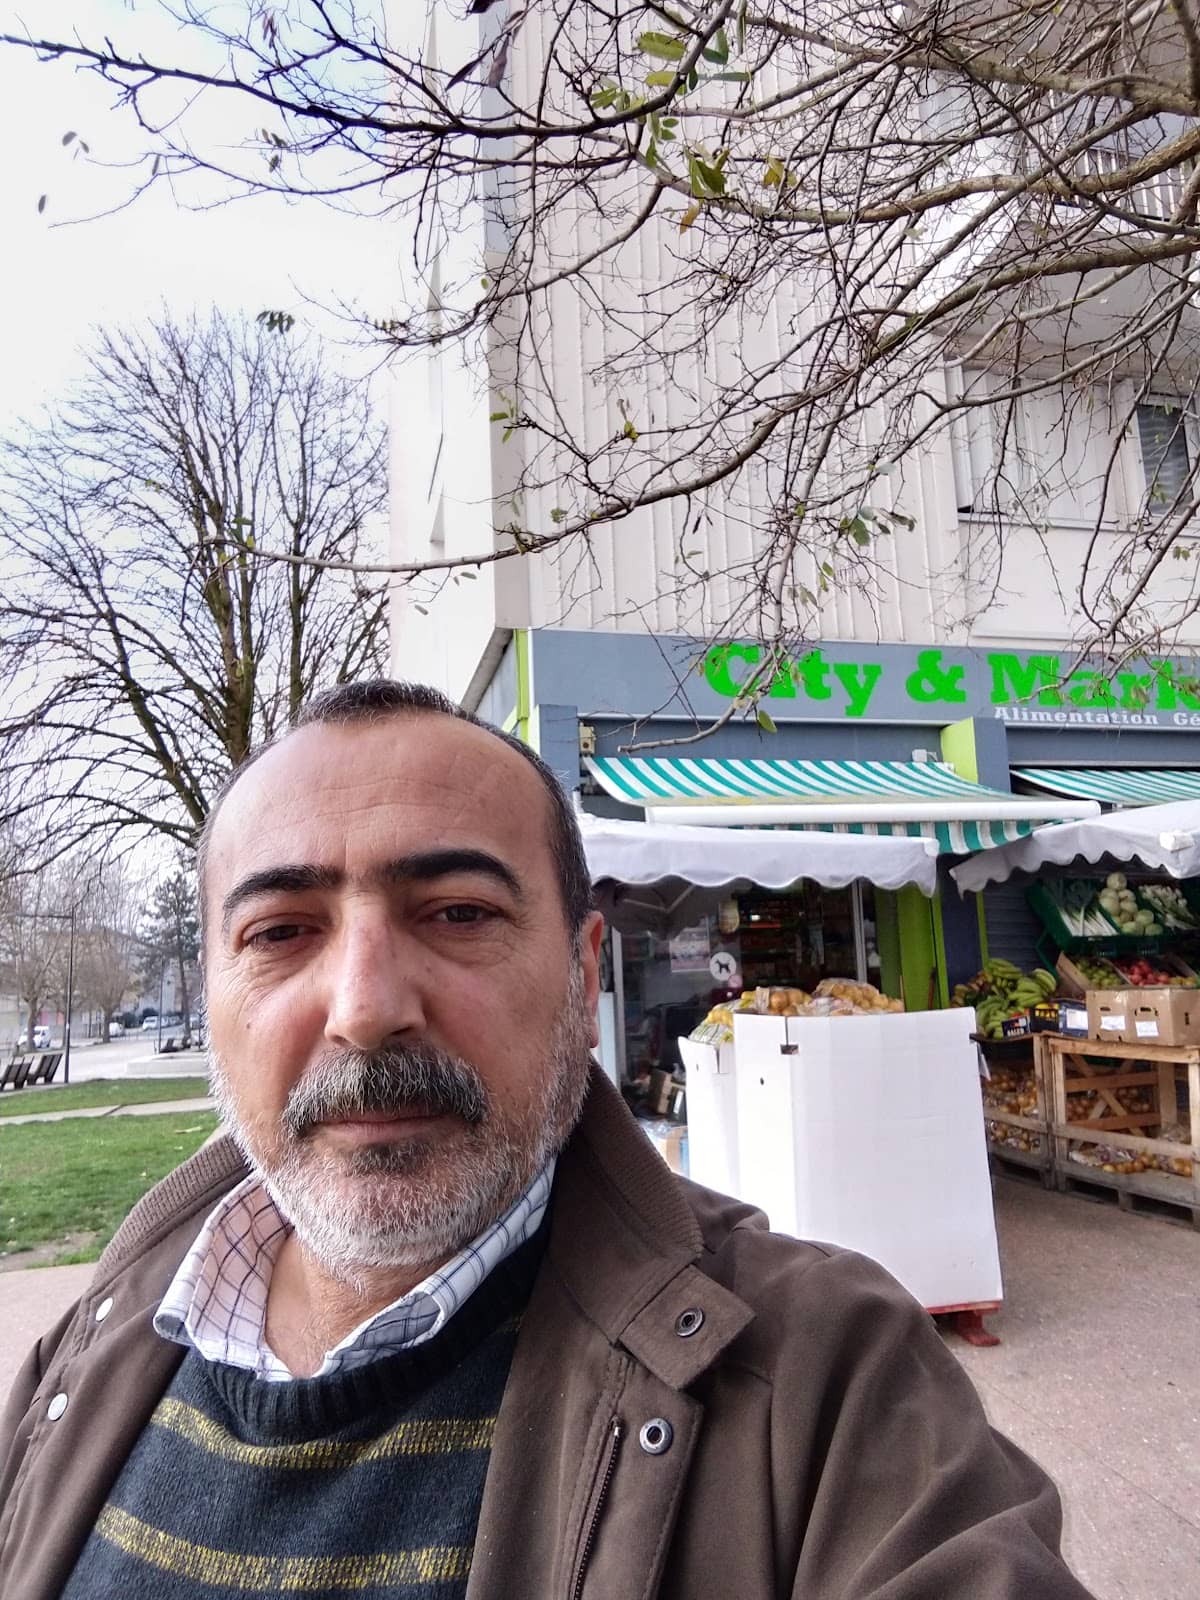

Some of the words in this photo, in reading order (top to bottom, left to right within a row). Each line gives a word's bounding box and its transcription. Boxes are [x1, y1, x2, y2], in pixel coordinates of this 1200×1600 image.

[703, 643, 882, 717] City
[905, 650, 967, 703] &
[993, 706, 1159, 725] Alimentation
